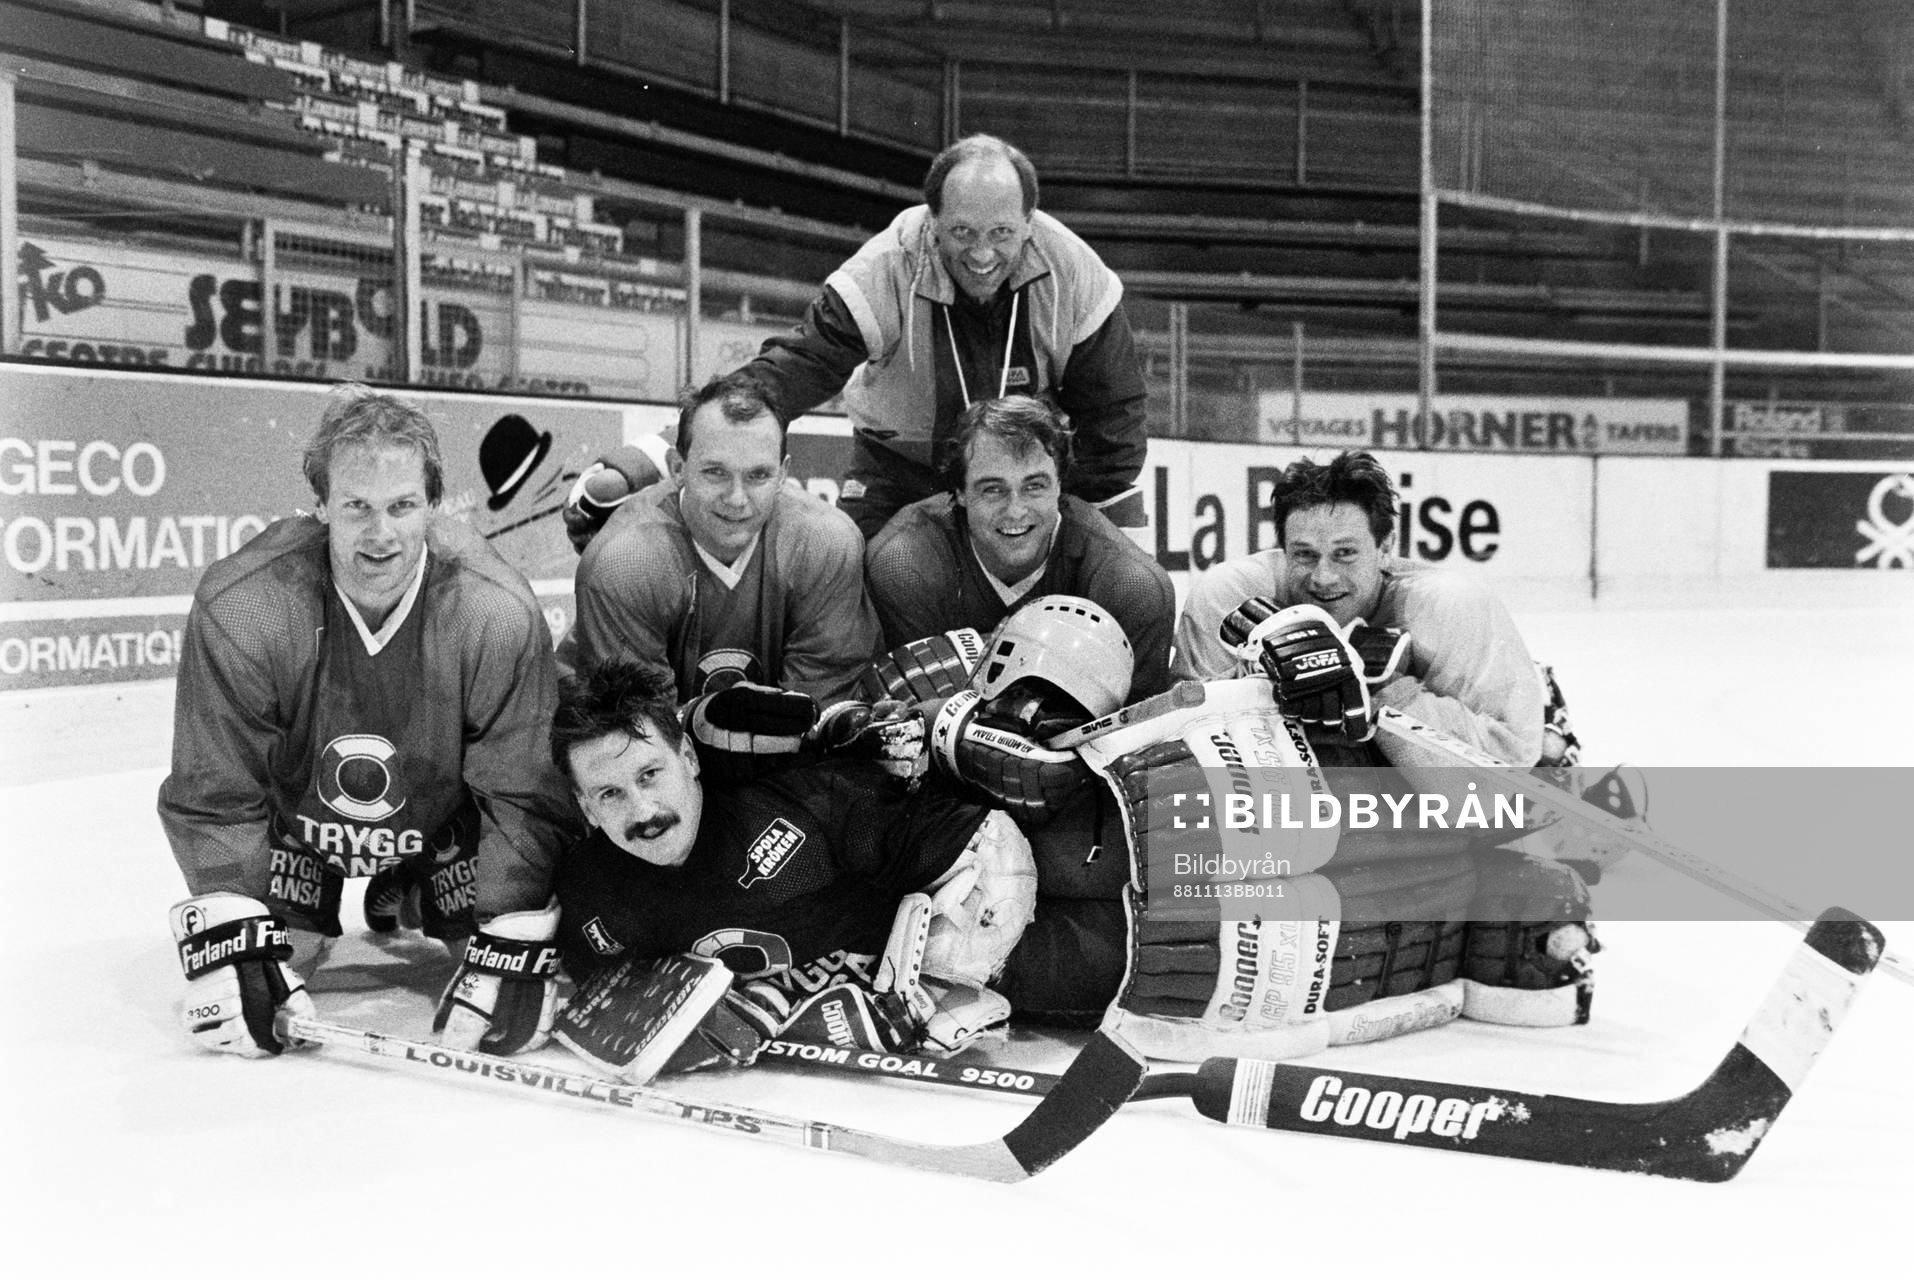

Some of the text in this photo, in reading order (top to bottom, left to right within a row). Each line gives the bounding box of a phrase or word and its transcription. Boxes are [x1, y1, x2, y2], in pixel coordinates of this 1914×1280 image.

[1373, 409, 1577, 449] HORNER
[1155, 466, 1226, 571] La
[1296, 652, 1341, 670] JOFA
[296, 815, 423, 857] TRYGG
[750, 828, 783, 863] SPOLA
[757, 830, 798, 876] KRÖKEN
[270, 849, 323, 884] RYGG
[269, 875, 322, 910] ANSA
[182, 928, 246, 974] Ferland
[464, 935, 529, 973] Ferland
[1219, 920, 1260, 1022] Cooper
[1304, 915, 1330, 1016] DURA-SOFT
[821, 999, 855, 1048] Coop
[404, 1046, 641, 1107] LOUISVILLE
[857, 1053, 939, 1077] GOAL
[960, 1067, 1035, 1090] 9500
[1299, 1076, 1500, 1140] Cooper
